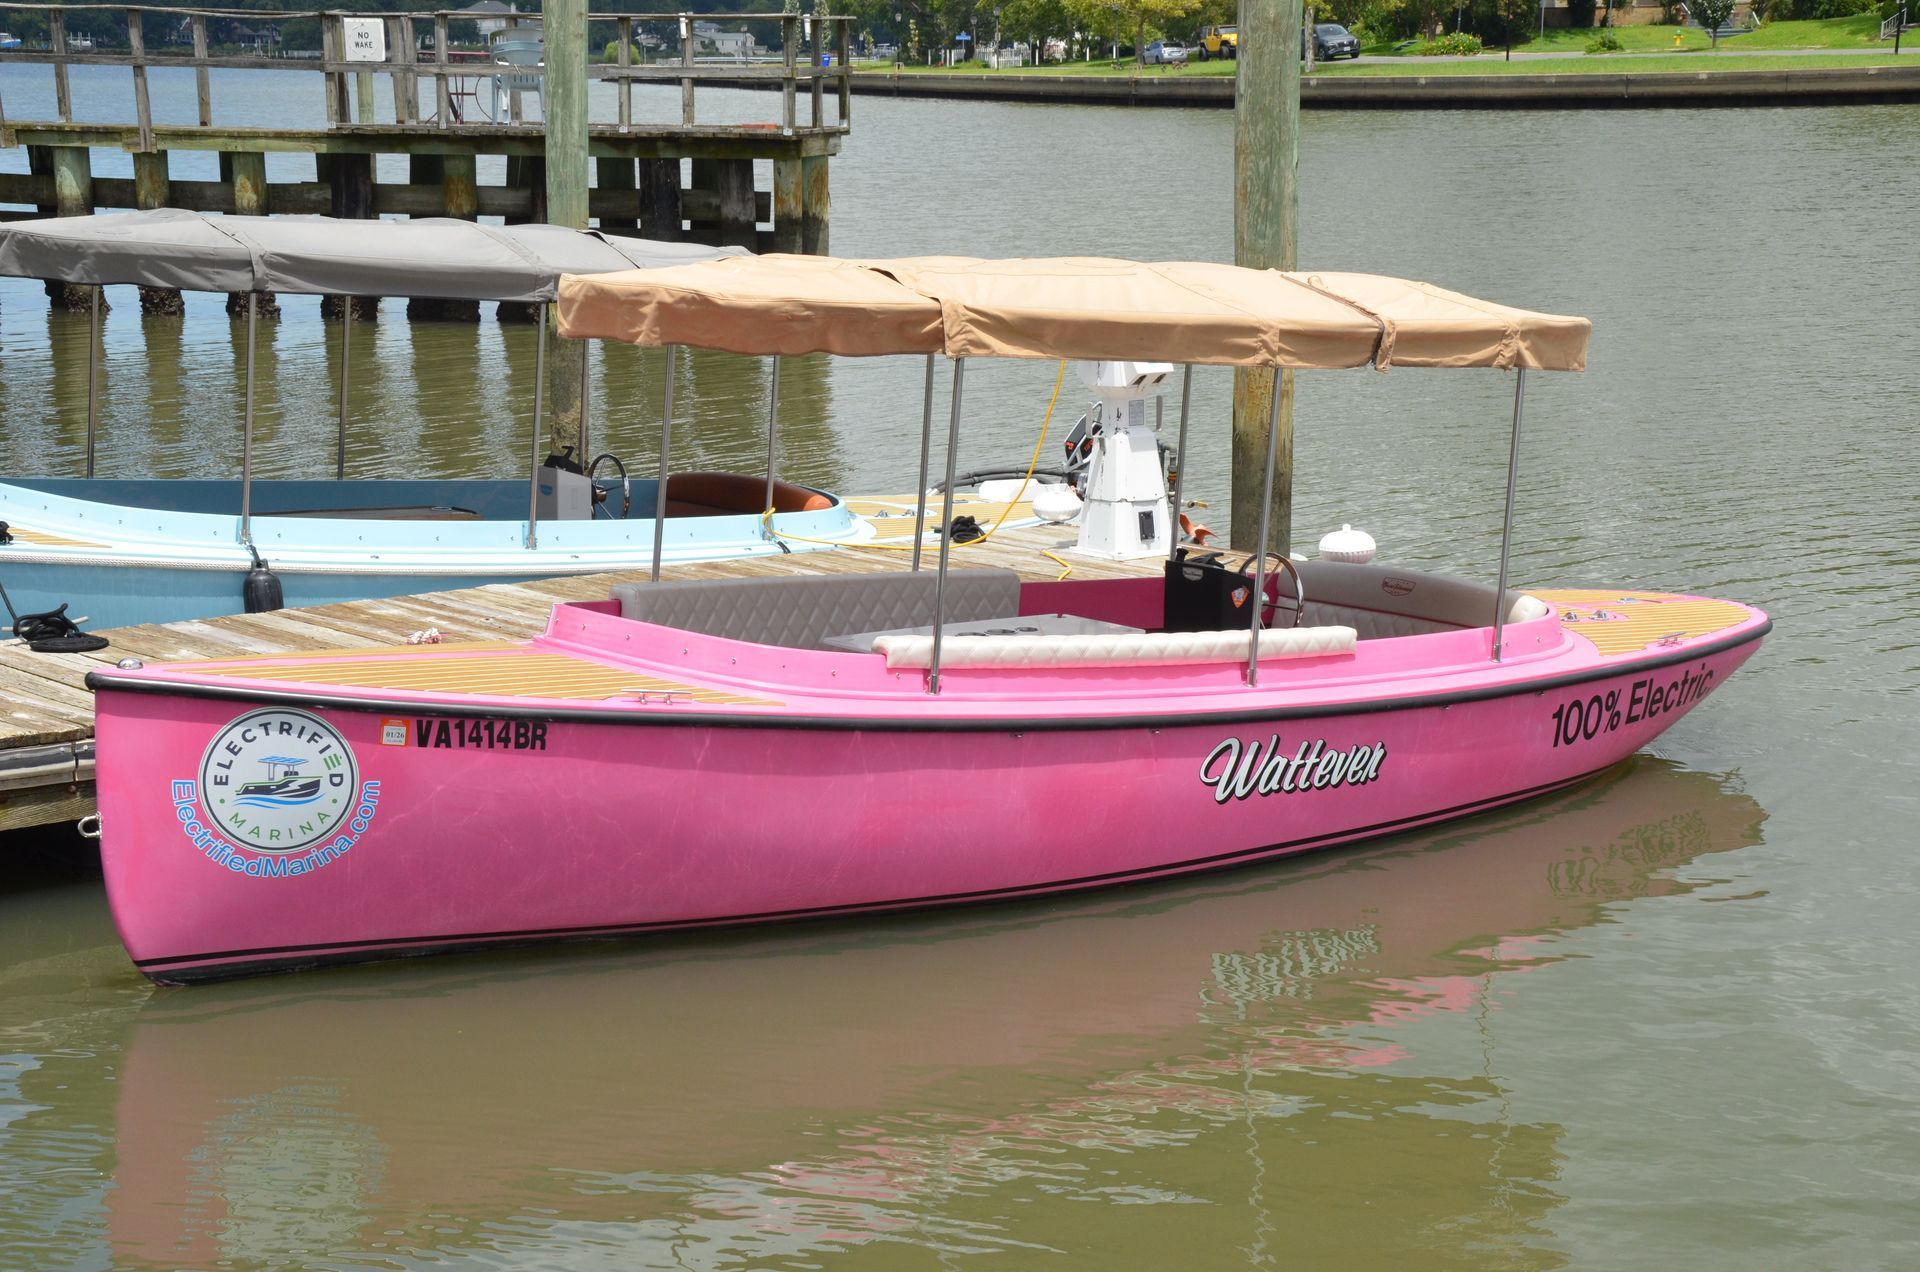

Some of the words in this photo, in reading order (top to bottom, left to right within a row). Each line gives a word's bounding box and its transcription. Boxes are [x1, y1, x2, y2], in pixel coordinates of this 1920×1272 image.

[354, 41, 373, 49] WAKE
[416, 719, 547, 750] VA1414BR
[1552, 689, 1621, 748] 100%
[1625, 663, 1714, 725] Electric
[213, 720, 344, 788] ELECTRIFIED
[1199, 733, 1387, 805] Wattever
[171, 779, 381, 878] ElectrifiedMarina.com
[229, 811, 331, 841] MARINA
